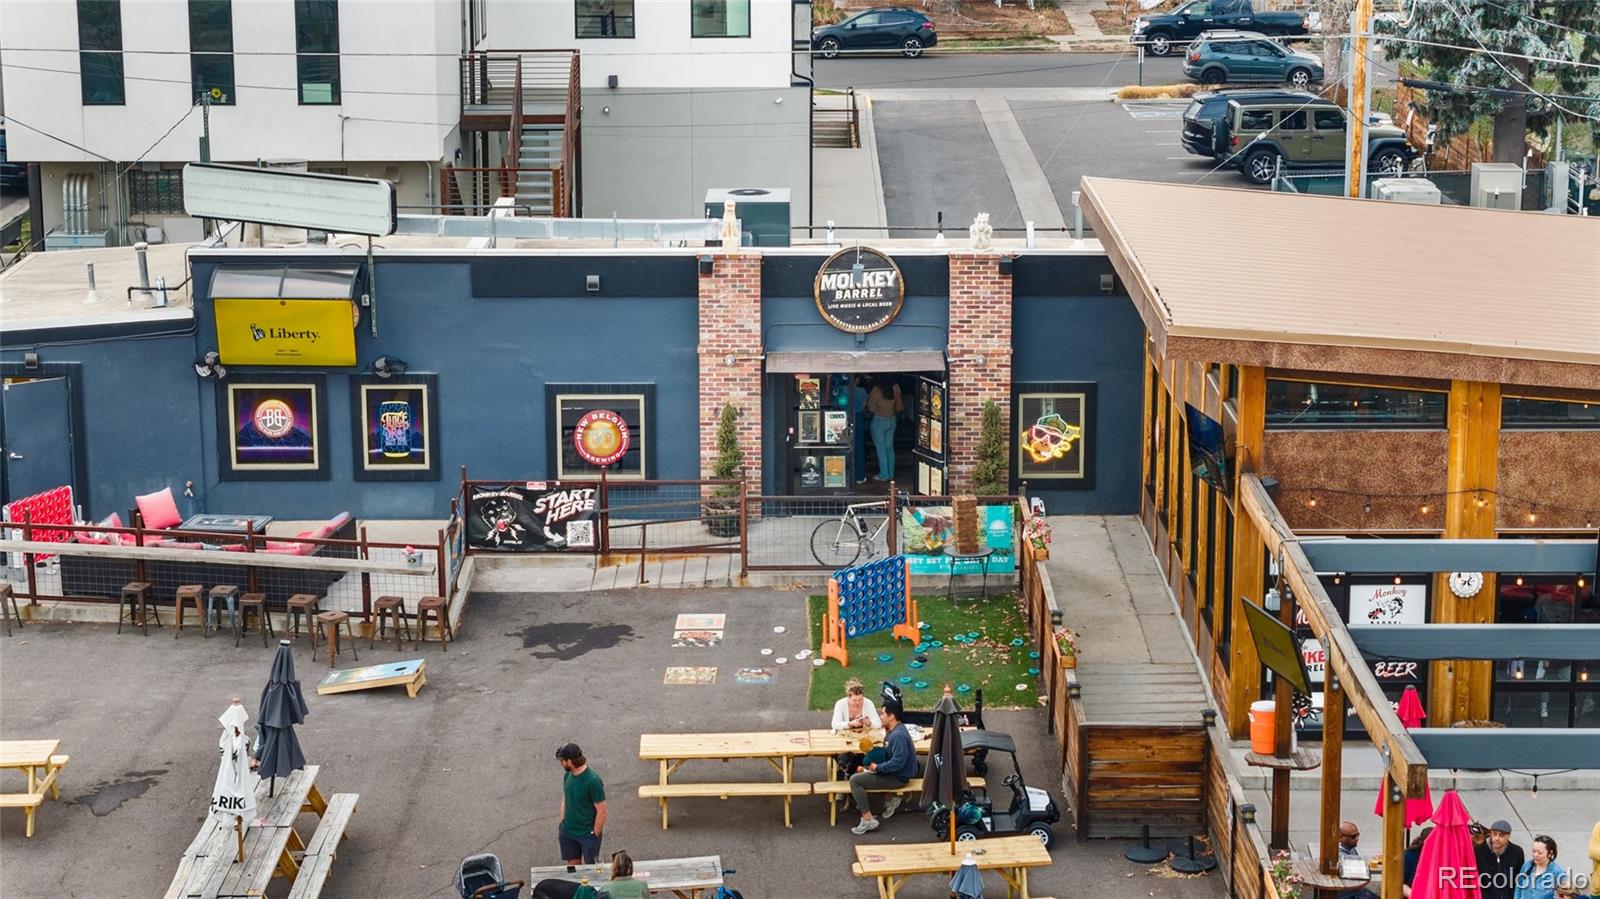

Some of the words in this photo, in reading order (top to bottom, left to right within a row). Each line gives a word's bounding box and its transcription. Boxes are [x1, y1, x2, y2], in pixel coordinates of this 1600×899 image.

[835, 288, 883, 299] BARREL
[576, 419, 589, 440] NEW
[591, 412, 628, 439] BELGIUM
[585, 453, 621, 463] BREWING
[533, 489, 595, 514] START
[546, 500, 596, 525] HERE
[1369, 587, 1407, 602] Monkey
[1374, 661, 1418, 680] BEER
